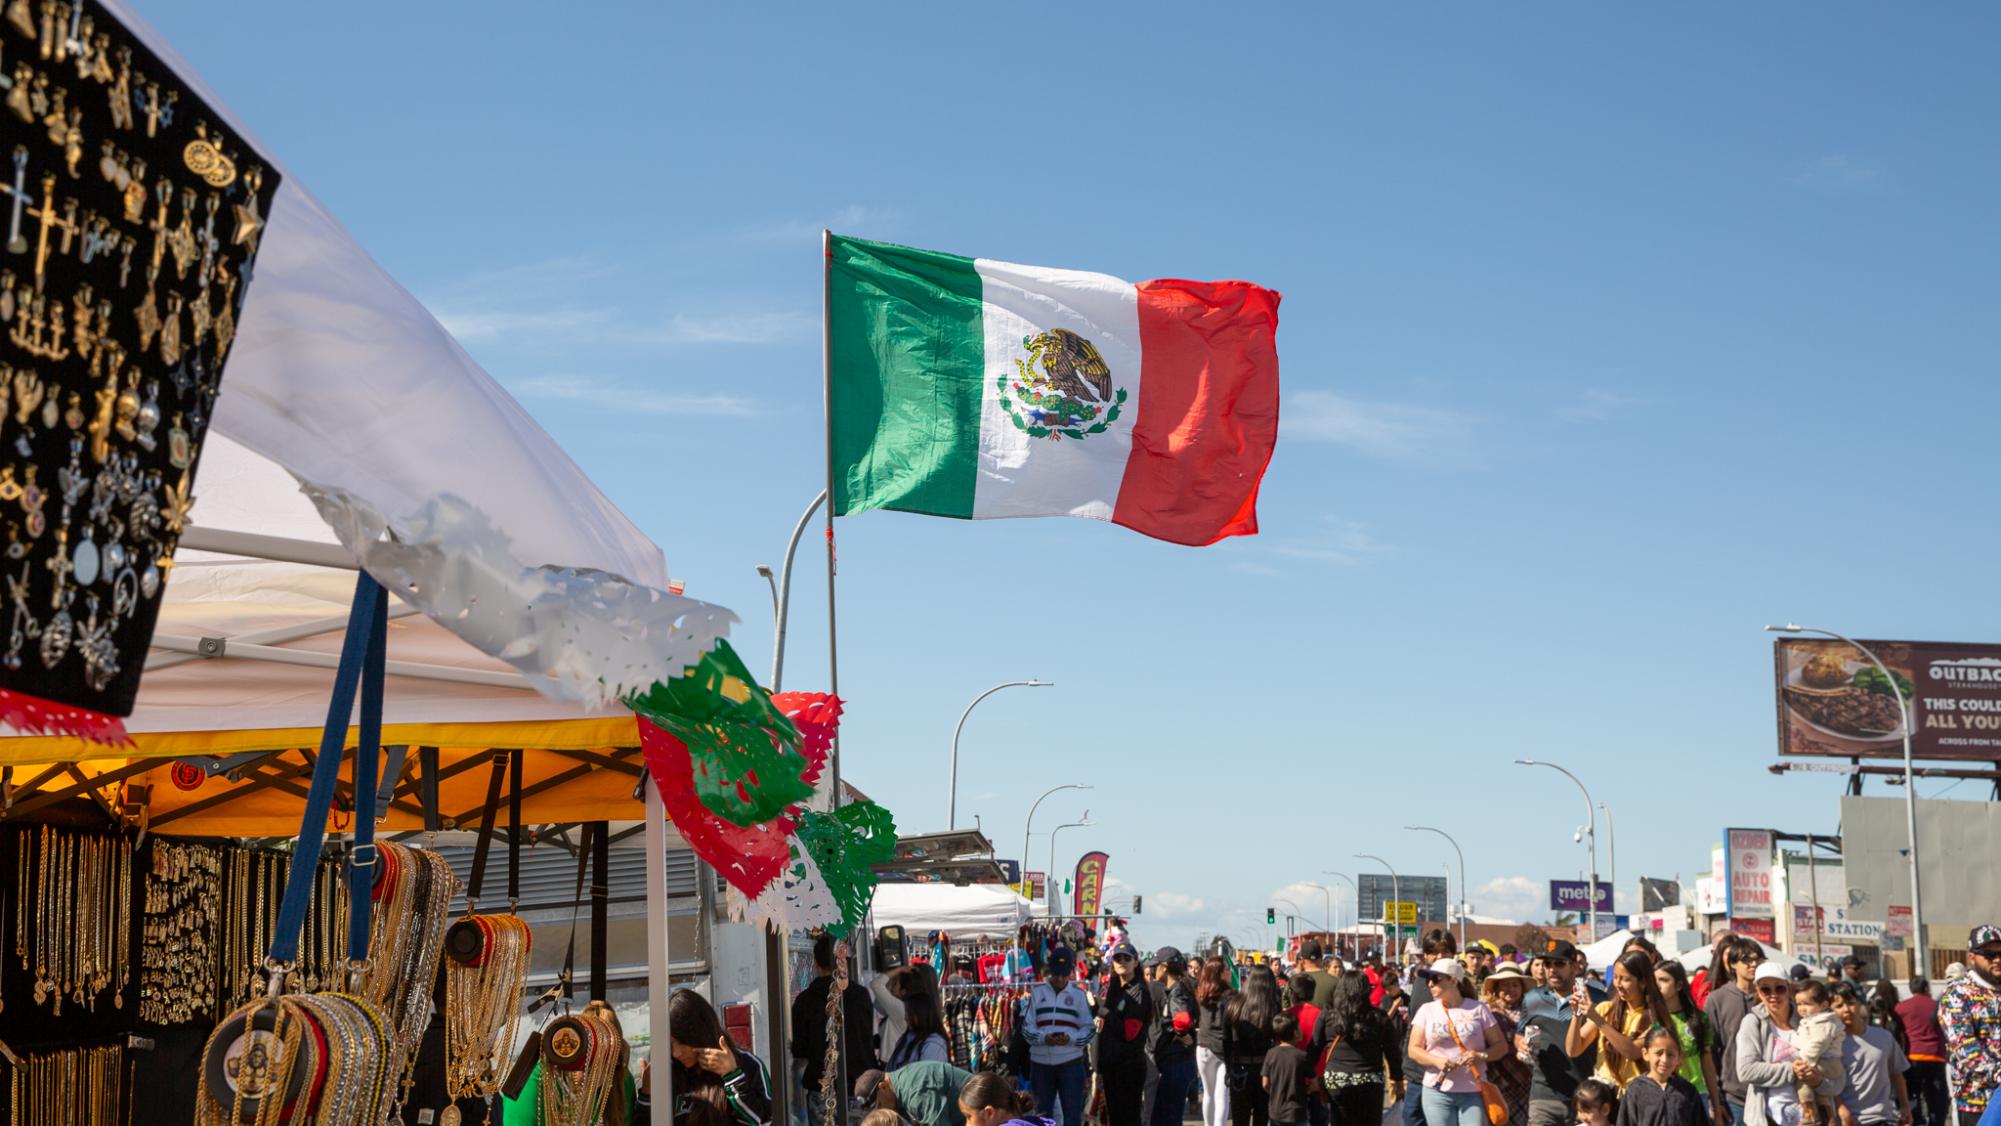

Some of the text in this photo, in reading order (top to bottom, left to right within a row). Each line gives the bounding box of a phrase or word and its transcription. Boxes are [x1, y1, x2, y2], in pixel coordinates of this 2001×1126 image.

[1923, 698, 1956, 710] THIS
[1925, 714, 2001, 729] ALL YOU
[1969, 738, 1990, 746] FROM
[1734, 872, 1768, 887] AUTO
[1558, 885, 1606, 901] meto
[1734, 889, 1770, 904] REPAIR
[1828, 923, 1880, 935] STATION
